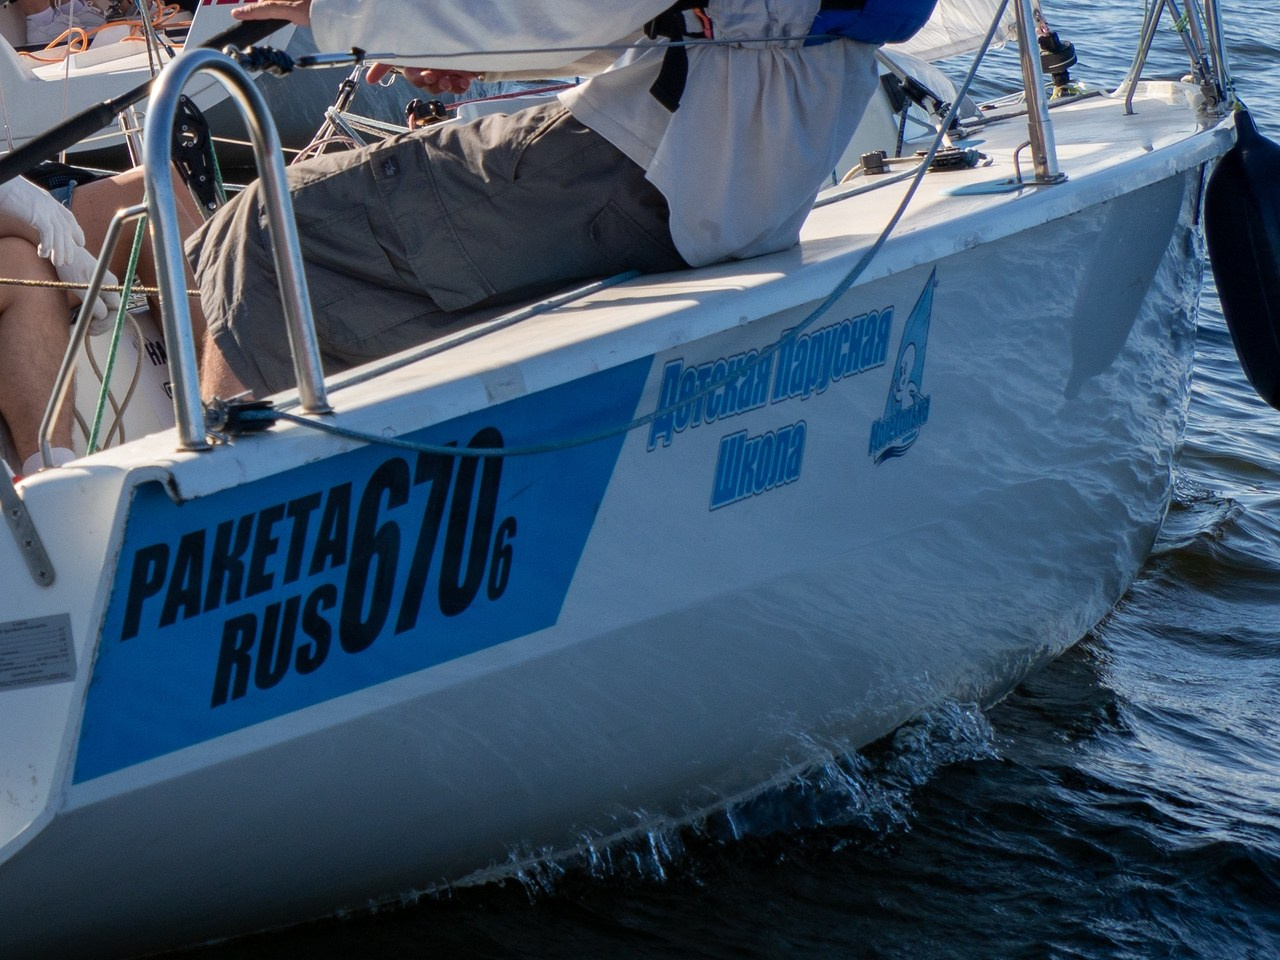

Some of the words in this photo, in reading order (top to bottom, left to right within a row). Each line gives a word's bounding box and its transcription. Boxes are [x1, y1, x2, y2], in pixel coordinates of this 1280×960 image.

[646, 343, 774, 452] Детская
[771, 305, 895, 405] Парусная
[709, 419, 808, 512] Школа
[210, 583, 338, 710] RUS
